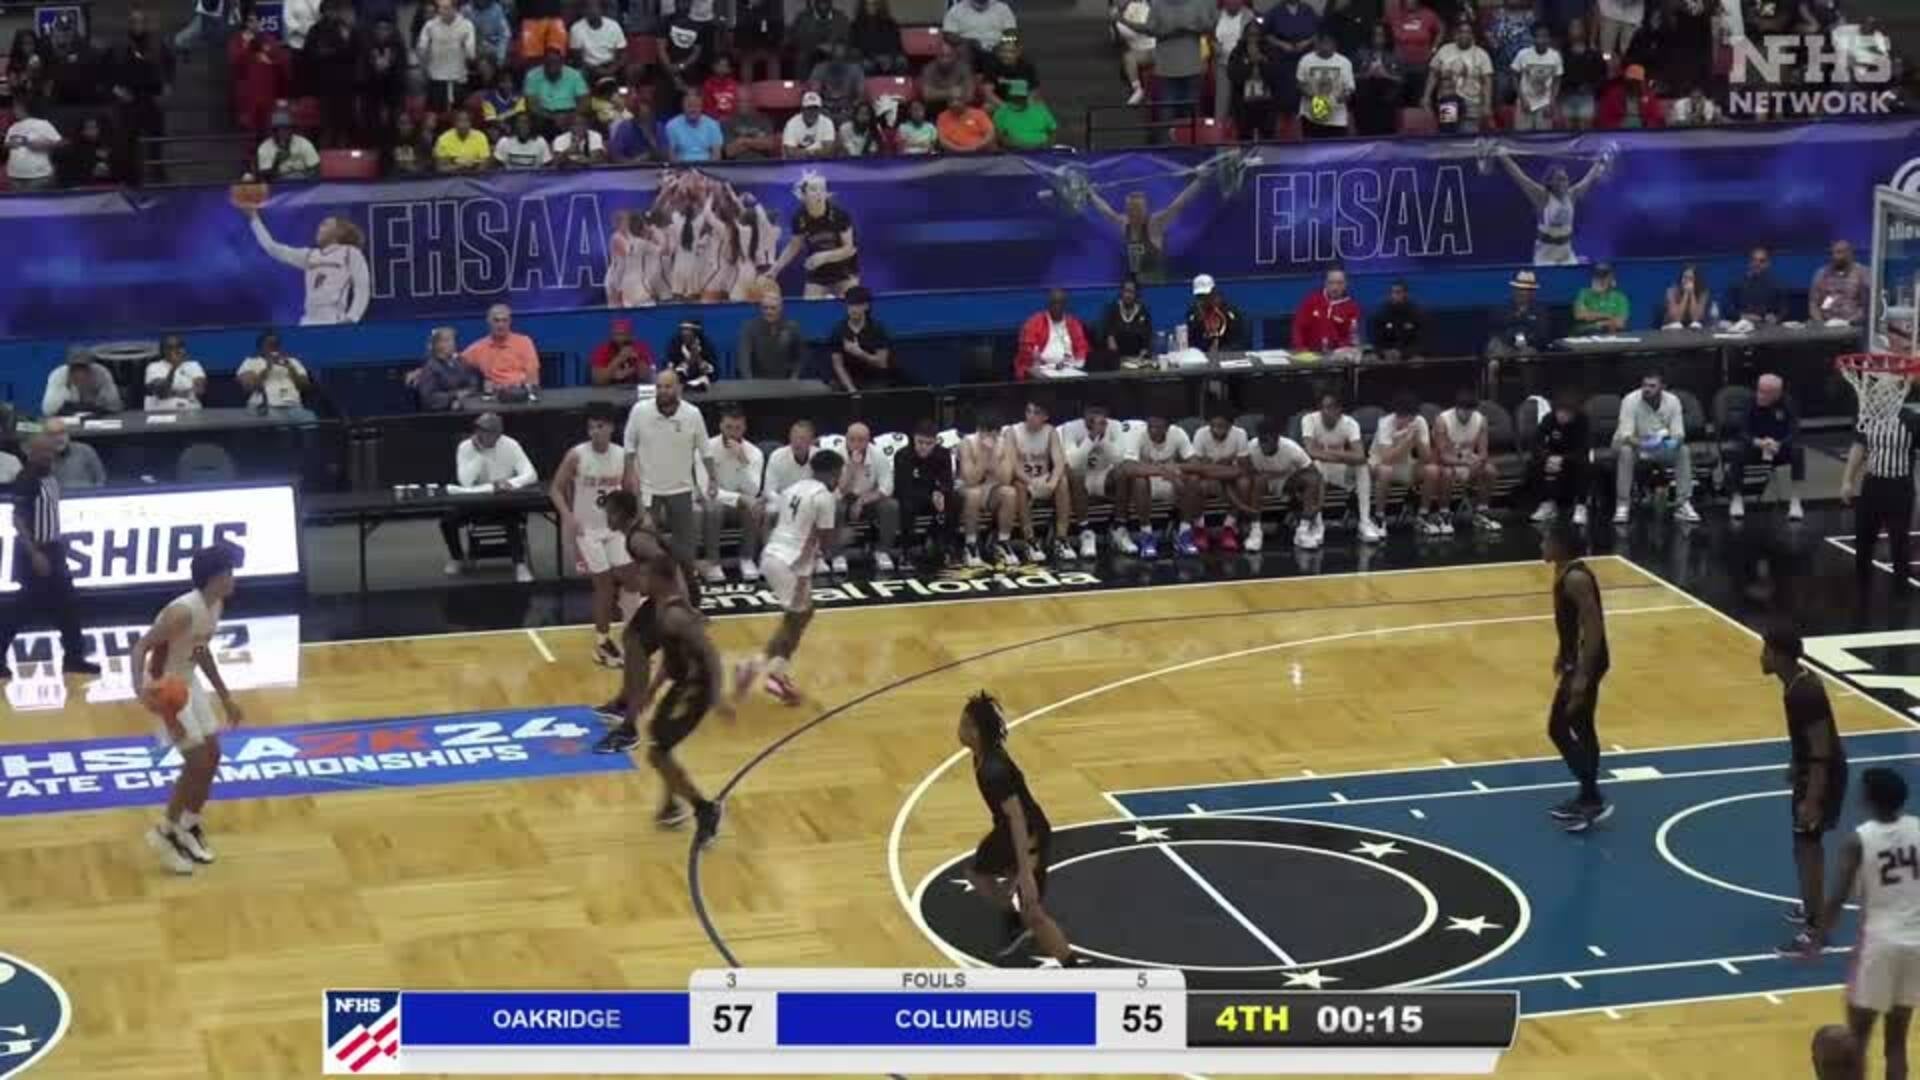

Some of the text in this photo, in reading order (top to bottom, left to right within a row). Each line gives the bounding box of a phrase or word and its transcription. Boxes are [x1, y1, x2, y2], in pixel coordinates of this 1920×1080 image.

[1256, 165, 1473, 264] FHSAA
[368, 193, 609, 299] FHSAA
[788, 494, 802, 521] 4
[10, 521, 248, 583] SHIPS
[868, 568, 1102, 600] Florida
[0, 743, 529, 797] ATE CHMPIONSHIPS
[1877, 846, 1920, 886] 24
